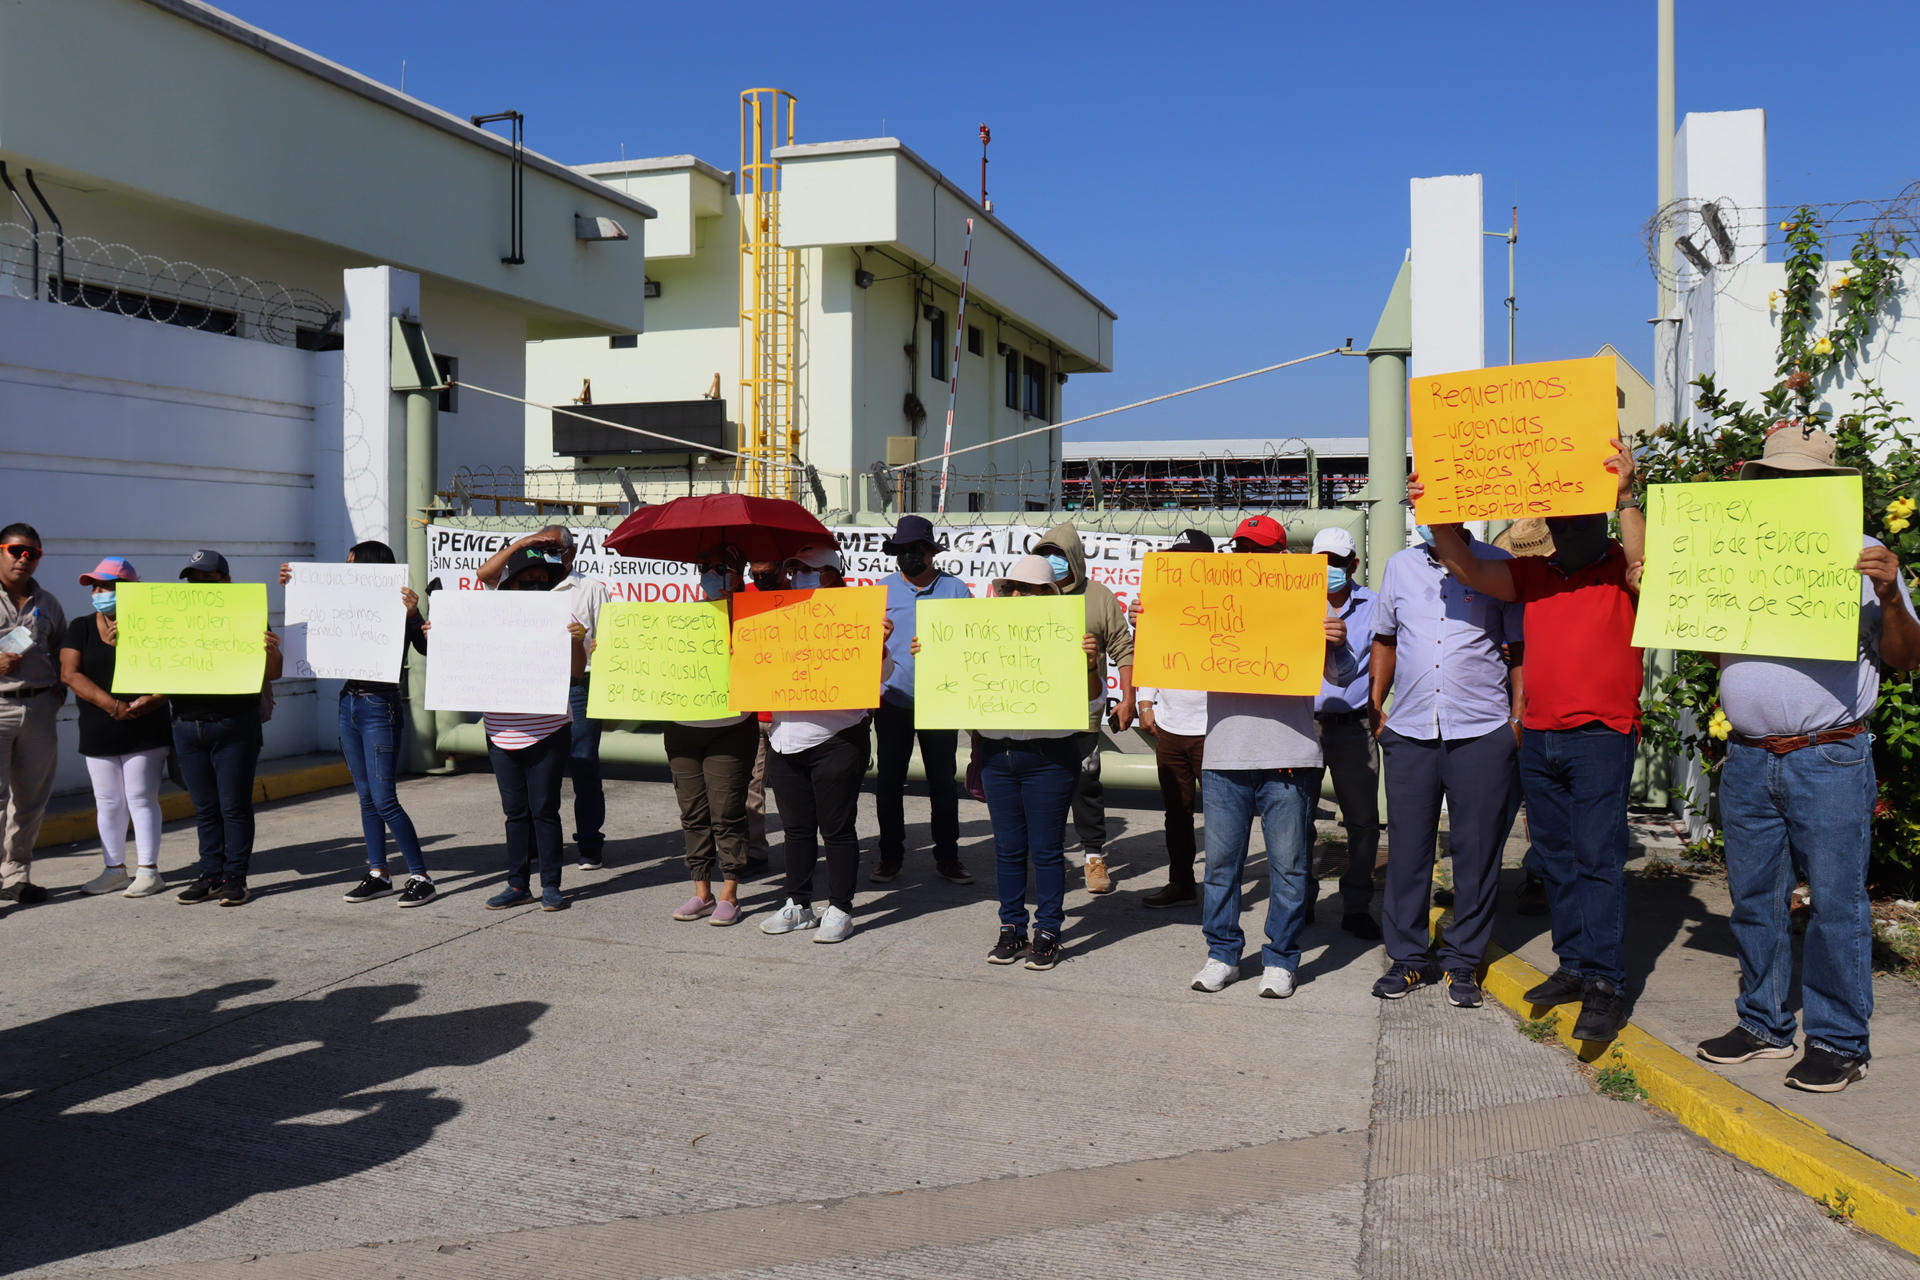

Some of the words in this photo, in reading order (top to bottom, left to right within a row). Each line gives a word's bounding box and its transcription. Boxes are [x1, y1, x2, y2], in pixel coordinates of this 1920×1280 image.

[1527, 461, 1541, 479] X
[1082, 535, 1121, 561] UE
[1672, 527, 1696, 557] el
[609, 560, 688, 578] ¡SERVICIOS
[971, 561, 1012, 577] HAY
[1092, 567, 1140, 586] EXIG
[1156, 556, 1183, 587] Pta
[1190, 558, 1244, 588] Claudia
[1748, 566, 1768, 590] un
[149, 585, 225, 612] Exigimos
[1668, 593, 1697, 613] por
[1747, 588, 1779, 616] de
[127, 611, 146, 632] No
[155, 615, 174, 630] se
[737, 618, 781, 643] retira
[794, 618, 808, 642] la
[813, 610, 871, 647] carpeta
[931, 620, 955, 643] No
[965, 618, 1001, 642] más
[1008, 612, 1076, 643] muertes
[702, 631, 725, 656] de
[753, 646, 773, 665] de
[1209, 633, 1242, 654] es
[791, 662, 811, 683] del
[963, 650, 990, 672] por
[998, 645, 1043, 676] falta
[1162, 651, 1191, 673] un
[1200, 645, 1290, 682] derecho
[936, 673, 960, 694] de
